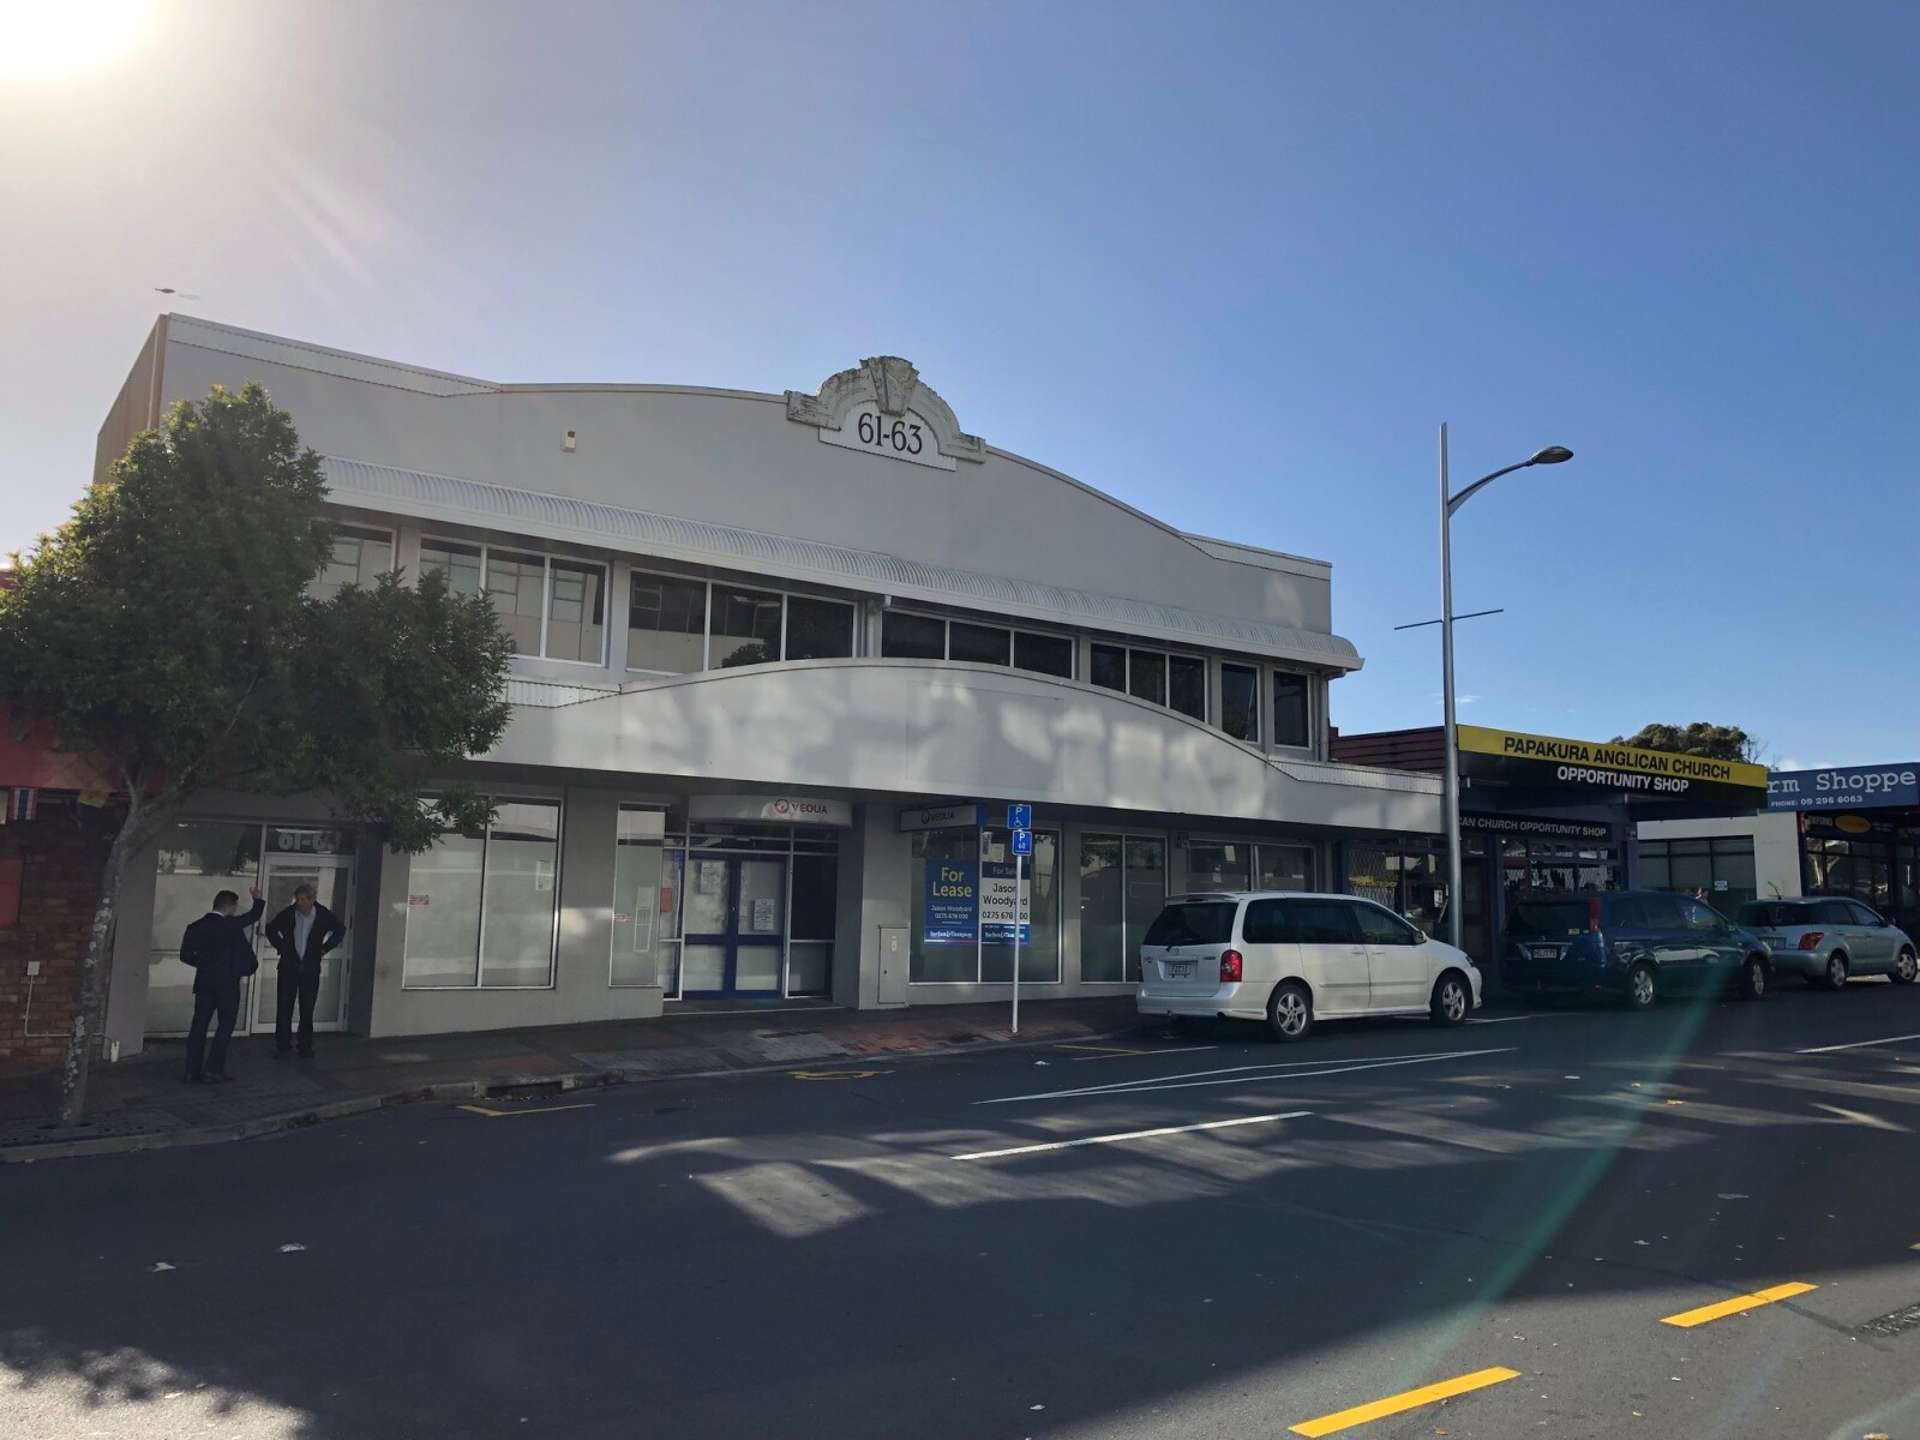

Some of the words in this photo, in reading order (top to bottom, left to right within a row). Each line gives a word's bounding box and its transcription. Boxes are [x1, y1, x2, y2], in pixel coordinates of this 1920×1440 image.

[858, 412, 923, 454] 61-63
[1504, 736, 1589, 761] PAPAKURA
[1593, 748, 1668, 772] ANGLICAN
[1672, 758, 1730, 780] CHURCH
[1557, 766, 1651, 789] OPPORTUNITY
[1653, 777, 1689, 793] SHOP
[1767, 778, 1800, 793] rm
[1816, 771, 1916, 793] Shoppe
[792, 803, 828, 815] VEOLIA
[1800, 798, 1812, 806] 09
[1016, 806, 1023, 816] P
[1478, 818, 1519, 831] CHURCH
[1519, 821, 1581, 836] OPPORTUNITY
[1582, 827, 1607, 837] SHOP
[1019, 832, 1026, 842] P
[941, 867, 965, 882] For
[932, 881, 973, 897] Lease
[982, 911, 1000, 920] 0275
